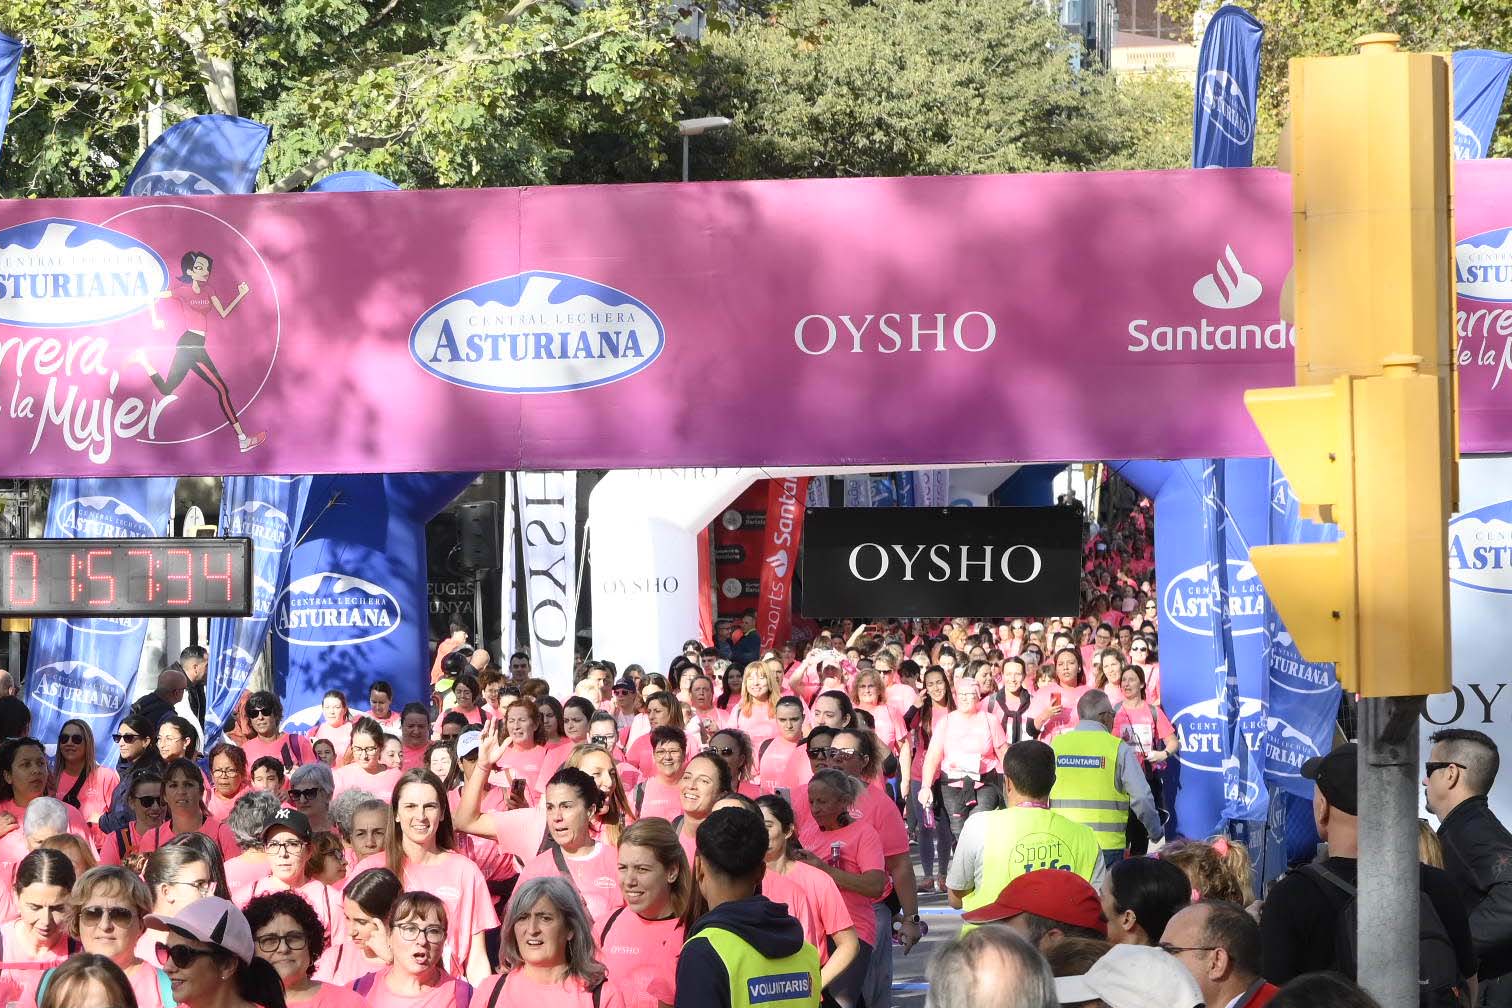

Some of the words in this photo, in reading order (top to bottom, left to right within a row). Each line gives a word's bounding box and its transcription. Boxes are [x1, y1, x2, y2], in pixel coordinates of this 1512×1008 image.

[469, 314, 544, 326] CENTRAL
[555, 312, 636, 324] LECHERA
[429, 318, 644, 363] ASTURIANA
[794, 311, 996, 355] OYSHO
[1478, 339, 1496, 366] la
[10, 386, 34, 419] la
[29, 368, 178, 464] Mujer
[848, 542, 1042, 583] OYSHO
[603, 576, 679, 594] OYSHO
[291, 598, 335, 606] CENTRAL
[338, 597, 387, 606] LECHERA
[278, 607, 391, 629] ASTURIANA
[37, 673, 120, 709] ASTURIANA
[1015, 839, 1063, 866] Sport
[750, 978, 809, 997] VOLUNTARIS
